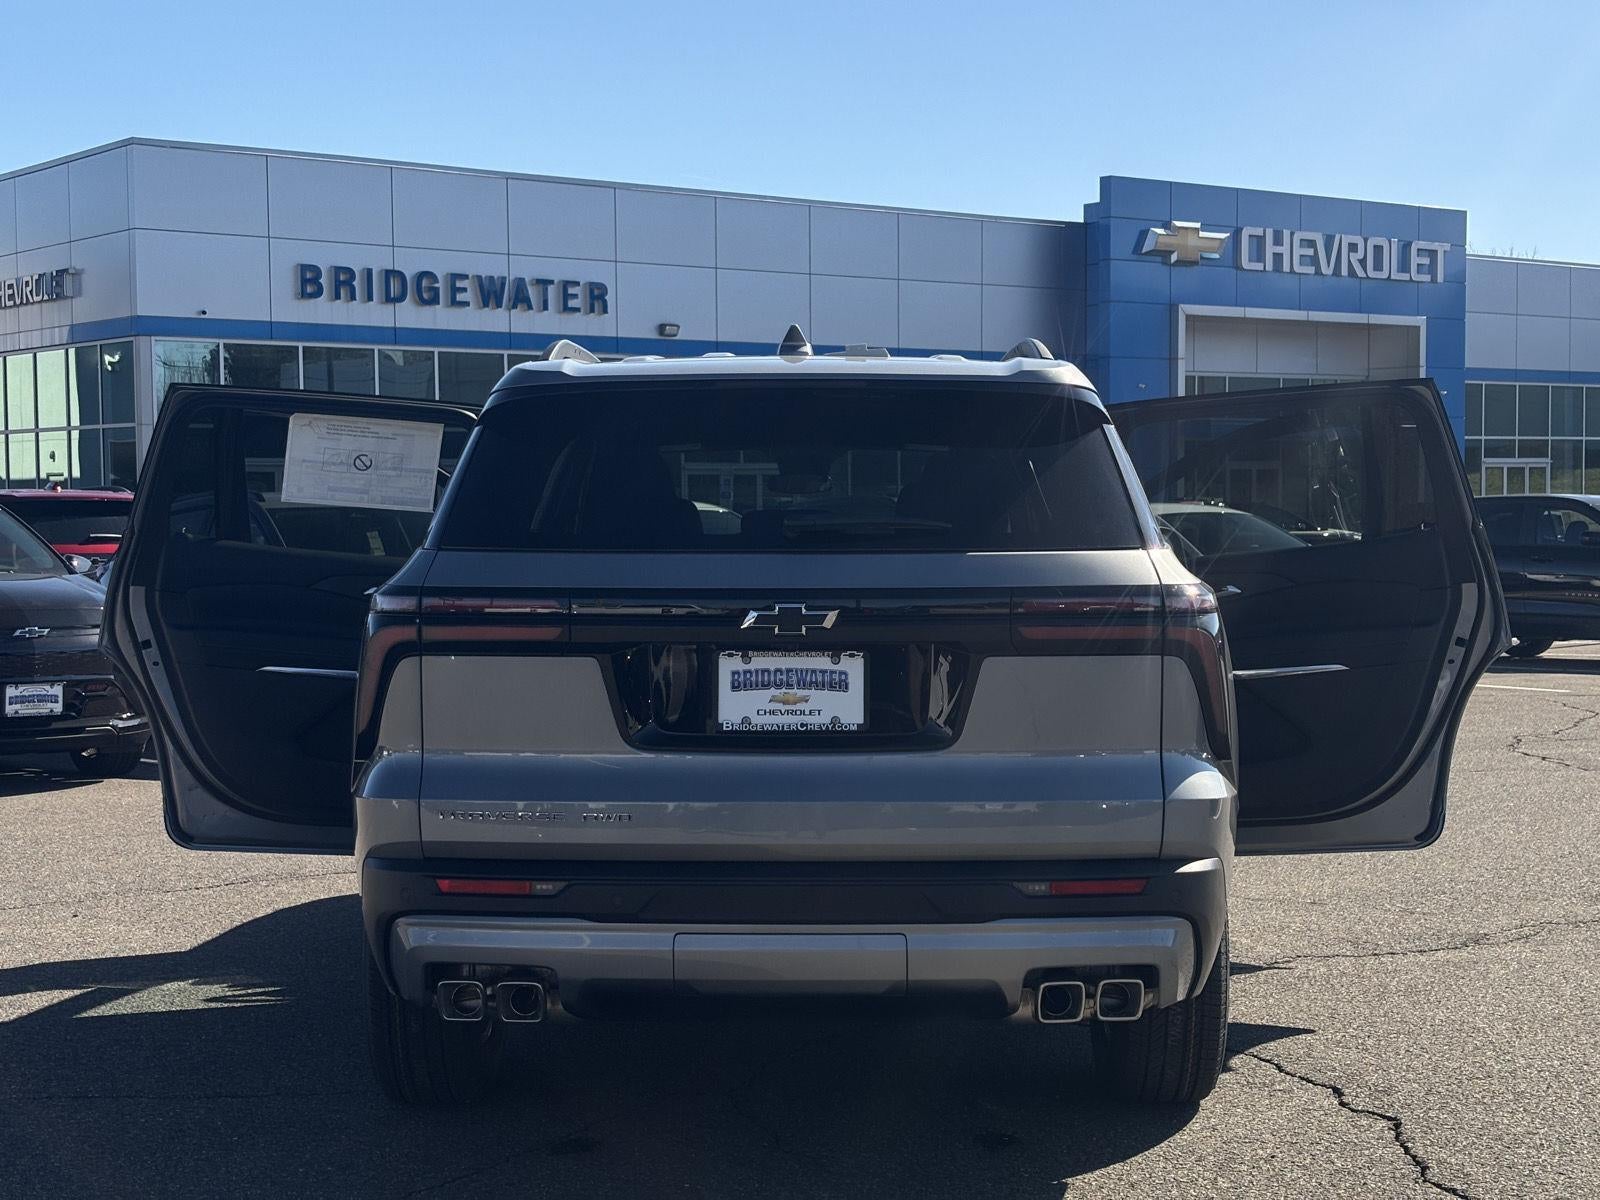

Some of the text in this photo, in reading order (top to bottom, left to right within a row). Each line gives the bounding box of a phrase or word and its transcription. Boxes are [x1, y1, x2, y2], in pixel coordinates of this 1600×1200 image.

[1242, 226, 1450, 283] CHEVROLET
[296, 263, 609, 315] BRIDGEWATER
[730, 668, 850, 692] BRIDGEWATER
[756, 708, 823, 717] CHEVROLET
[582, 813, 632, 822] AWD
